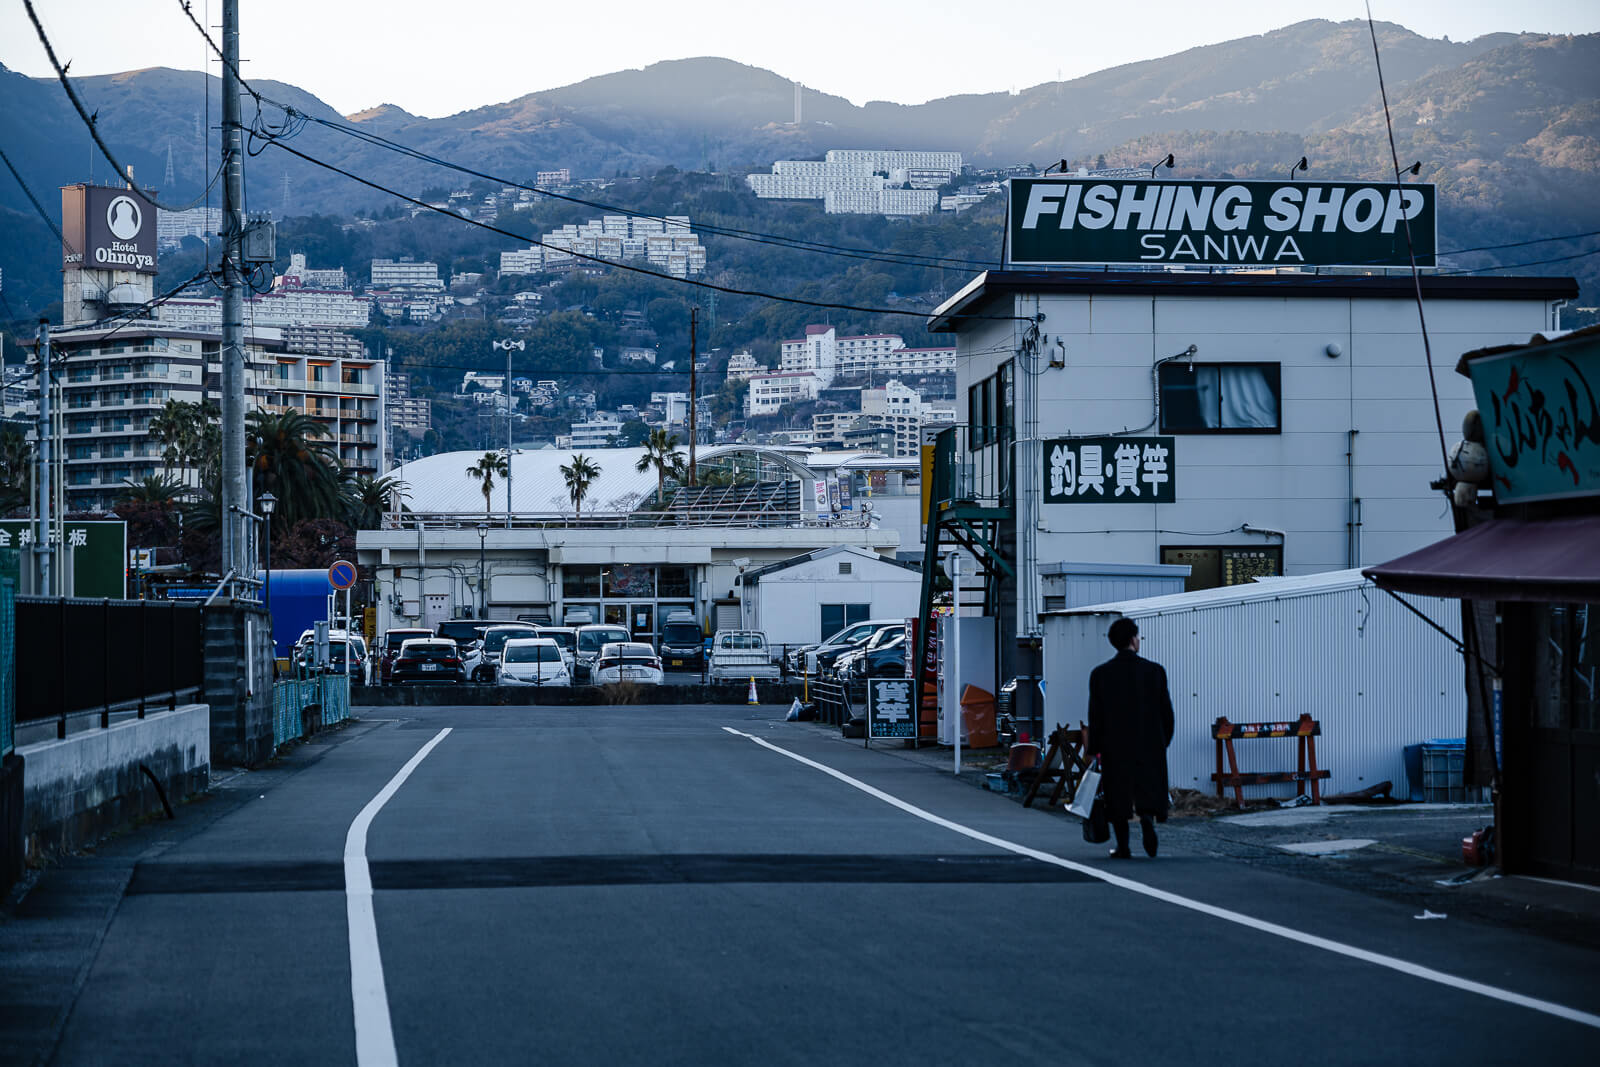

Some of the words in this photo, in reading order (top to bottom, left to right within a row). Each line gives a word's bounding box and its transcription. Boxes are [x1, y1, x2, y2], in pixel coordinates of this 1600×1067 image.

[1021, 184, 1253, 231] FISHING
[1263, 186, 1425, 234] SHOP
[95, 247, 154, 269] Ohnoya
[112, 241, 138, 253] Hotel
[1140, 234, 1305, 261] SANWA
